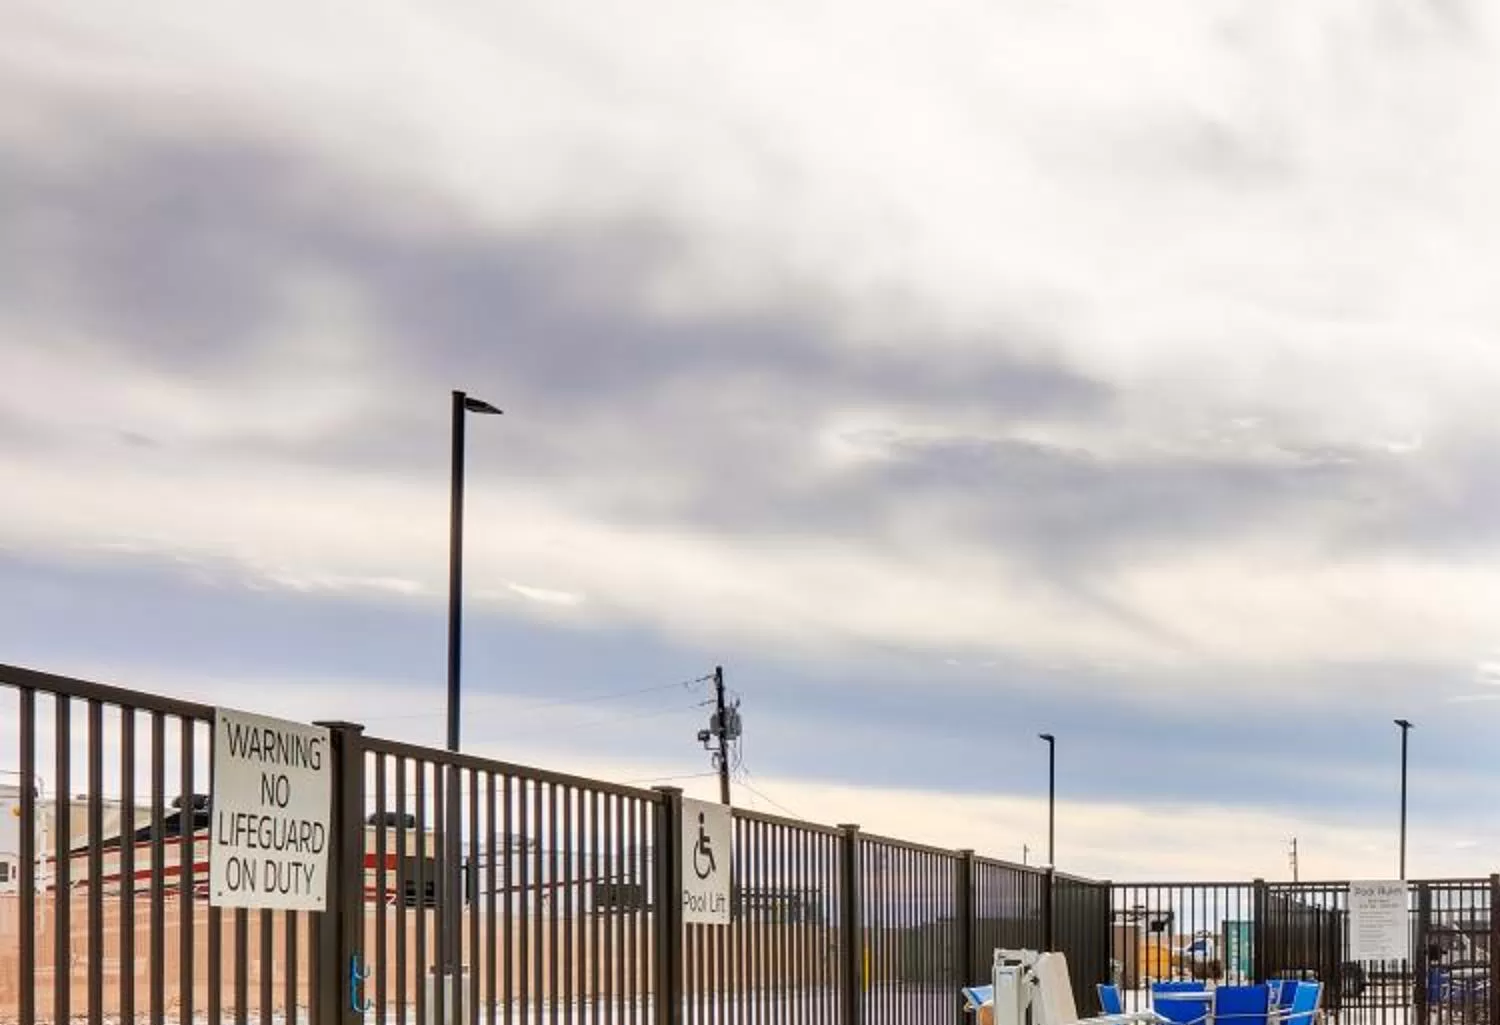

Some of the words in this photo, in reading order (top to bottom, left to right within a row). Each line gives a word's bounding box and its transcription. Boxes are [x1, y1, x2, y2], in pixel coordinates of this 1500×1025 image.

[226, 723, 322, 771] WARNING
[261, 772, 290, 808] NO
[218, 812, 325, 854] LIFEGUARD
[226, 856, 257, 892] ON
[264, 859, 316, 895] DUTY
[683, 889, 707, 912] Pool
[709, 891, 726, 913] Lift
